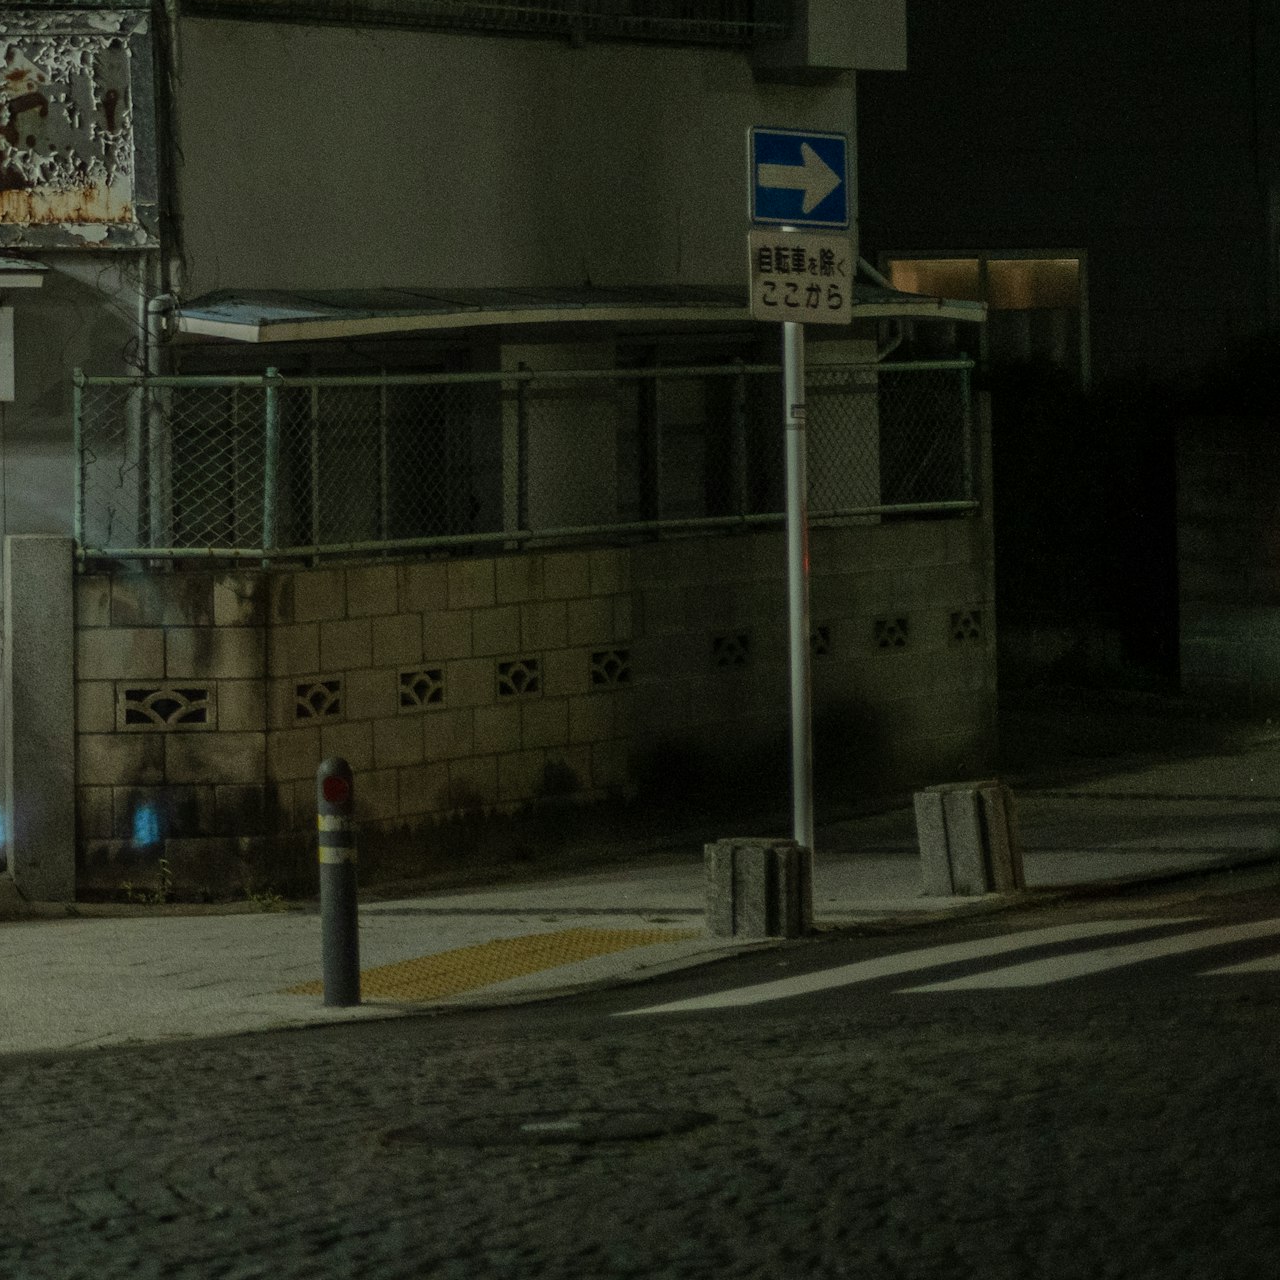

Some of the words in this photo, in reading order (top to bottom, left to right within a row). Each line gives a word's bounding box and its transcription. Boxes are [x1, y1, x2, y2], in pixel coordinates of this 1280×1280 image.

[758, 246, 845, 277] 自転車を除く
[762, 281, 843, 310] ここから
